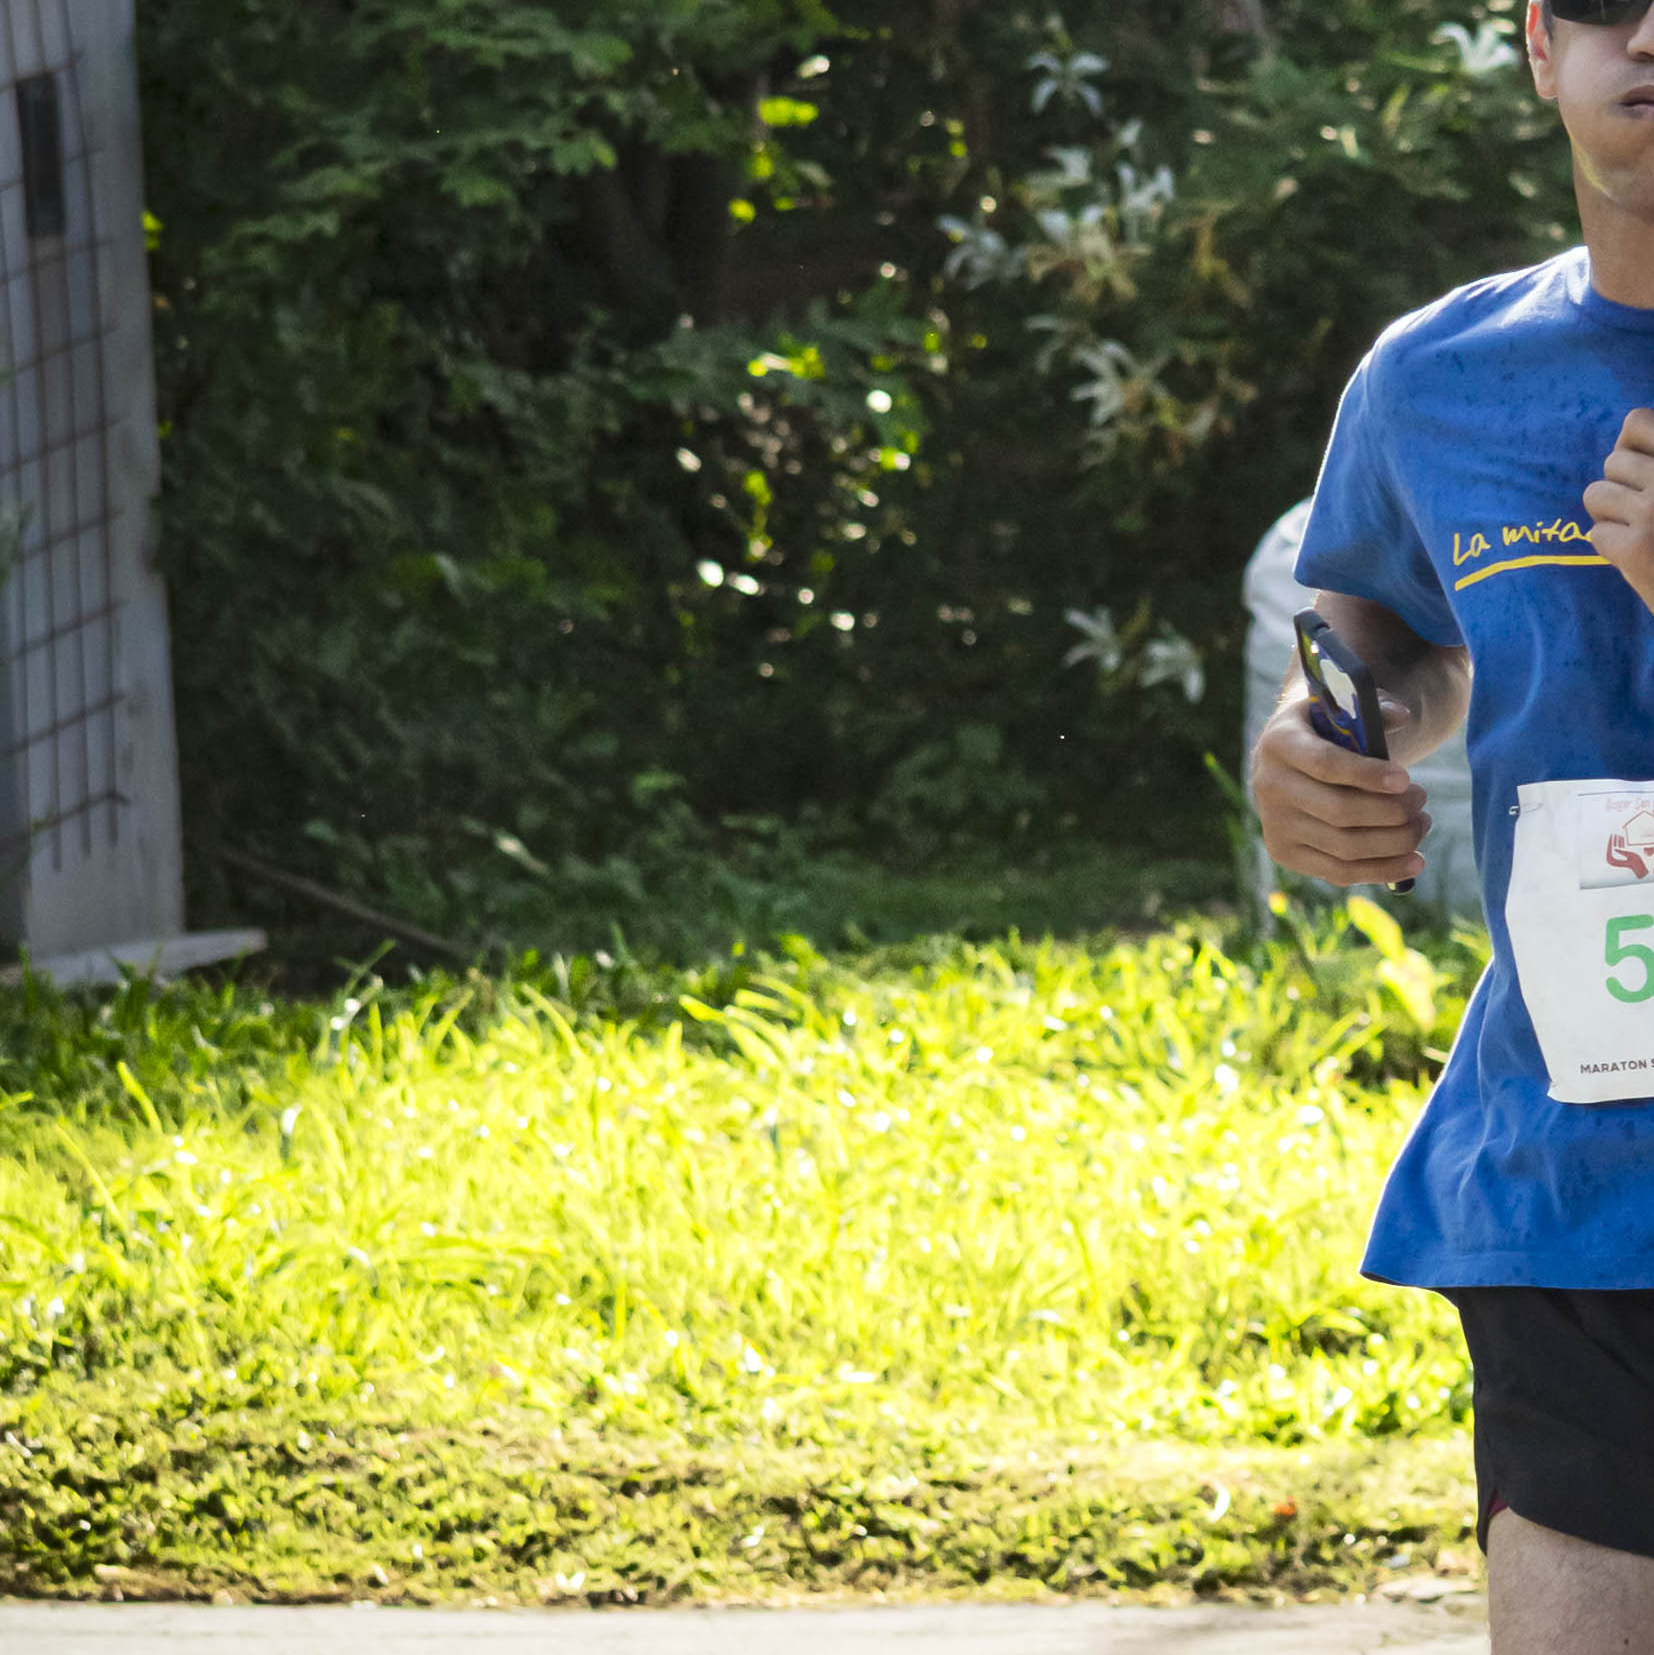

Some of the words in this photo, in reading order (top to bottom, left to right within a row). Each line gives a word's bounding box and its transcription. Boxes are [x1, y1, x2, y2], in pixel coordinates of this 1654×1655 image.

[1453, 532, 1491, 565] La
[1502, 518, 1592, 546] mita
[1580, 1058, 1647, 1074] MARATON
